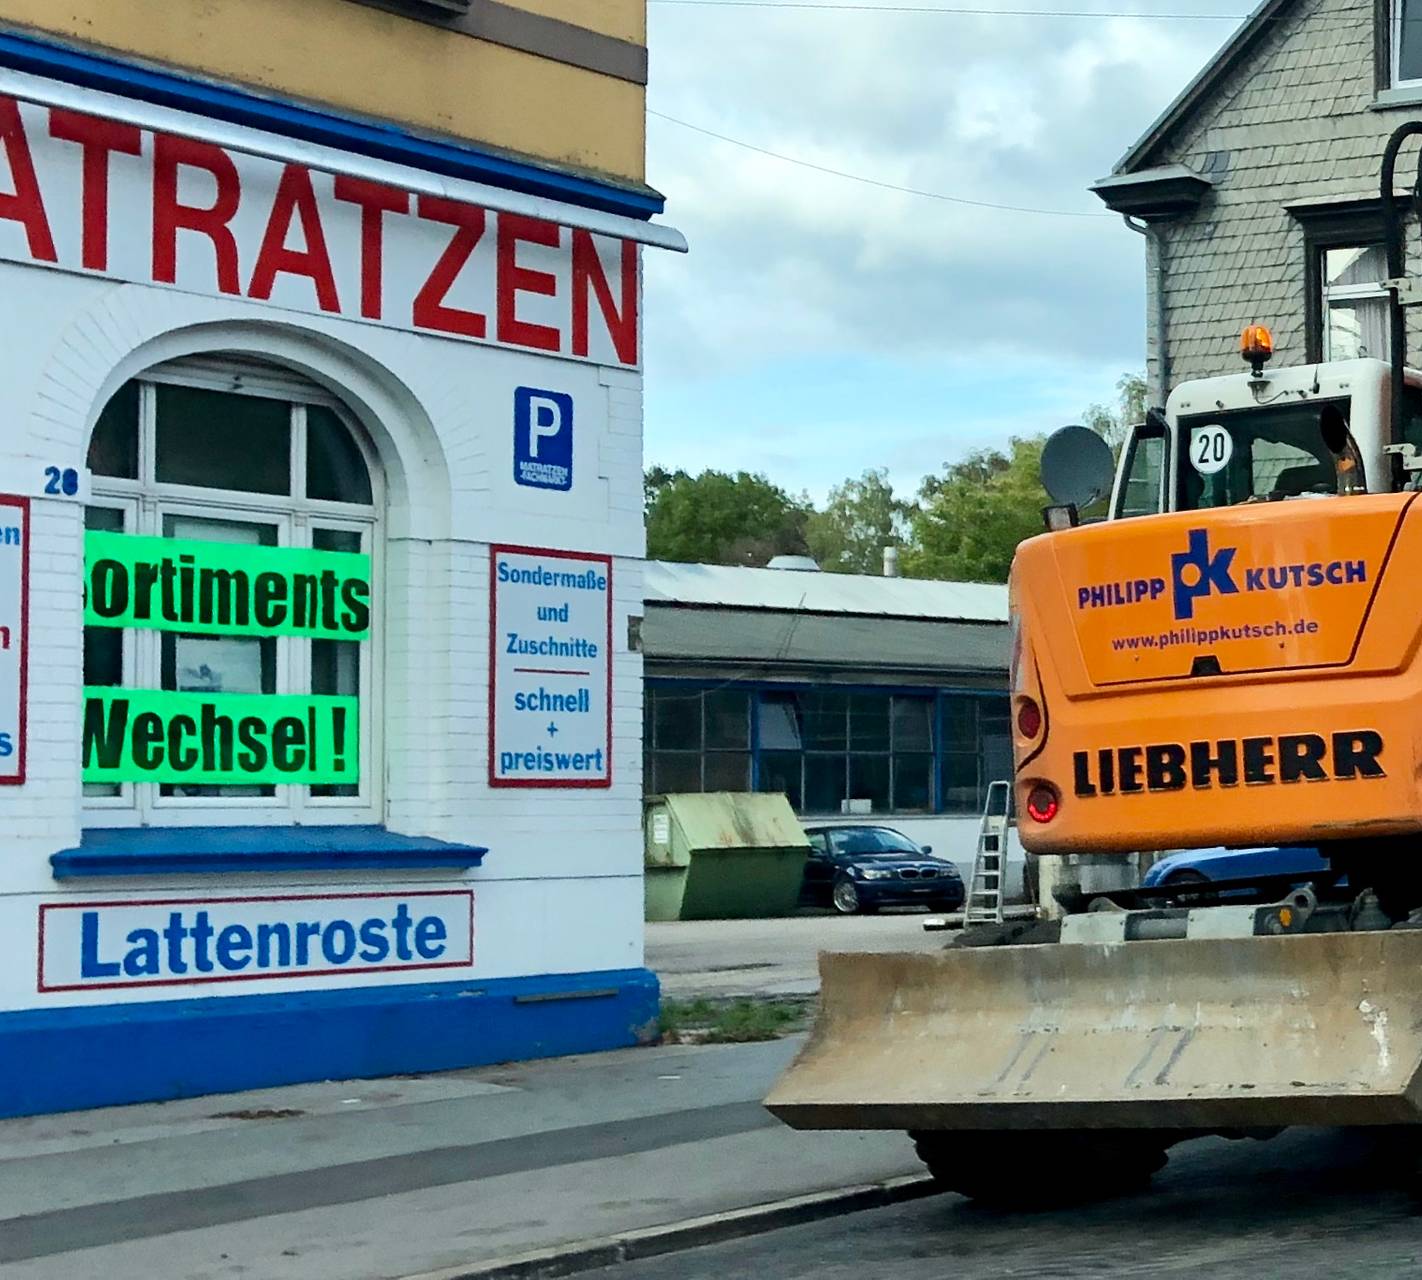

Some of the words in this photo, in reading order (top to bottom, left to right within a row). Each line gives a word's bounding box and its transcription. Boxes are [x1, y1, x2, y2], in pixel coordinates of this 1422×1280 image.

[528, 395, 562, 458] P
[1198, 432, 1225, 464] 20
[497, 561, 607, 591] Sondermaße
[1078, 577, 1165, 609] PHILIPP
[1246, 560, 1367, 592] KUTSCH
[537, 602, 569, 623] und
[506, 632, 598, 659] Zuschnitte
[1112, 618, 1319, 652] www.philippkutsch.de
[514, 686, 591, 713] schnell
[501, 745, 603, 775] preiswert
[1072, 729, 1387, 798] LIEBHERR
[80, 903, 448, 979] Lattenroste
